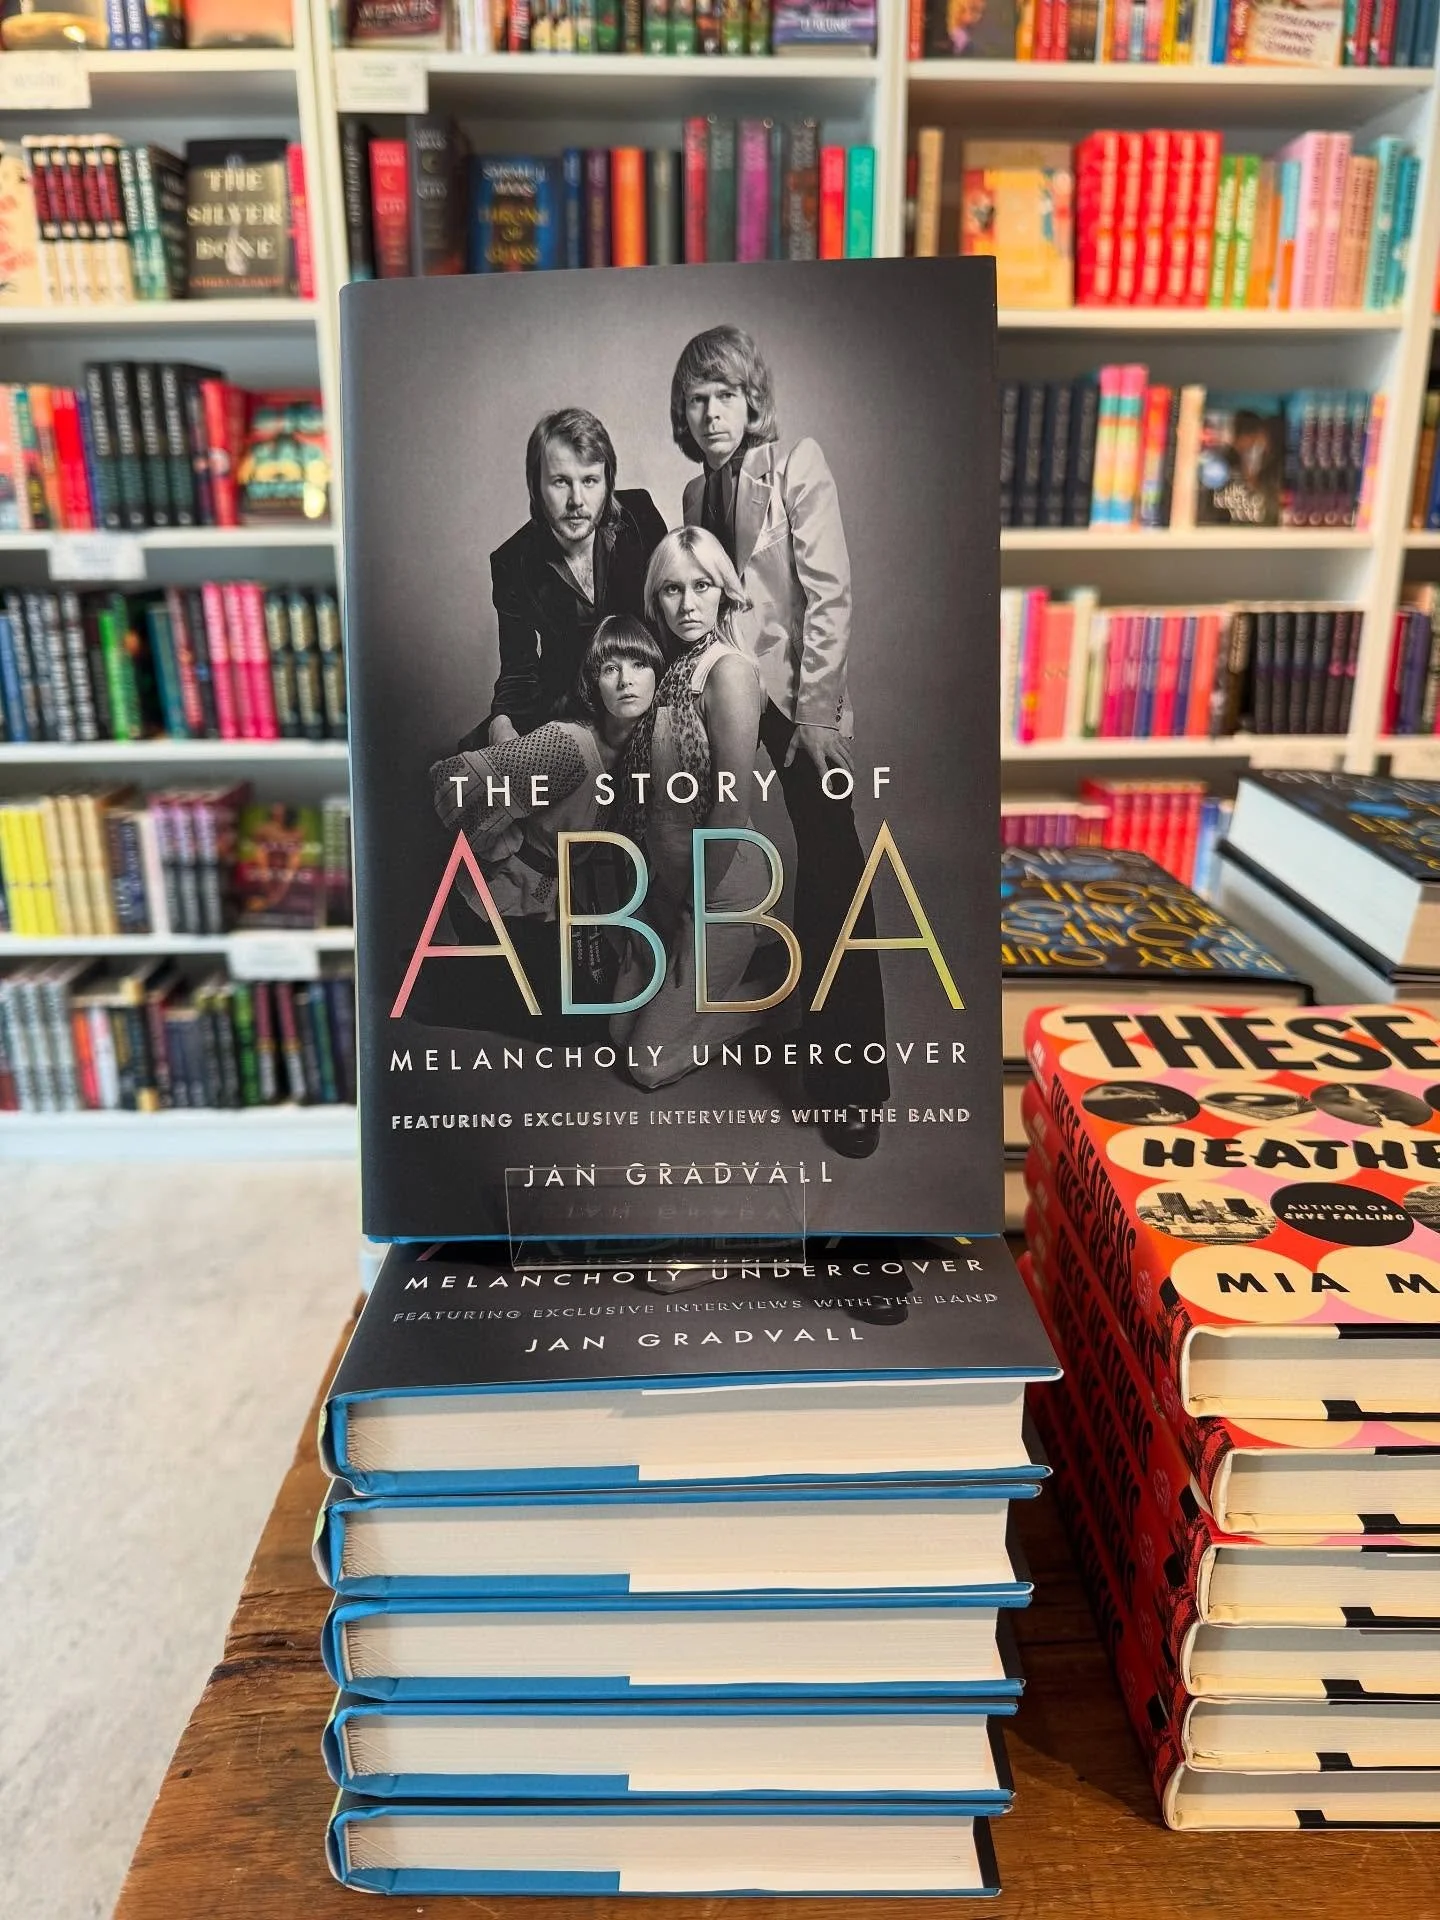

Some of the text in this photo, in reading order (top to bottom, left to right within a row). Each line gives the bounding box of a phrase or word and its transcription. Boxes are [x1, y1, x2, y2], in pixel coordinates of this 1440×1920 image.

[204, 168, 263, 192] THE
[187, 203, 282, 226] SILVER
[449, 766, 890, 808] THE STORY OF
[389, 818, 966, 1018] ABBA
[1064, 1015, 1440, 1071] THESE
[390, 1042, 966, 1072] MELANCHOLY UNDERCOVER
[392, 1108, 970, 1130] FEATURING EXCLUSIVE INTERVIEWS WITH THE BAND
[524, 1161, 833, 1188] JAN GRADVALL
[1284, 1213, 1407, 1222] SKYE FALLING
[1287, 1204, 1389, 1212] AUTHOR OF
[404, 1259, 984, 1290] MELANCHOLY UNDERCOVER
[1217, 1272, 1350, 1293] MIA
[393, 1293, 998, 1322] FEATURING EXCLUSIVE INTERVIEWS WITH THE BAND
[525, 1327, 865, 1353] JAN GRADVALL
